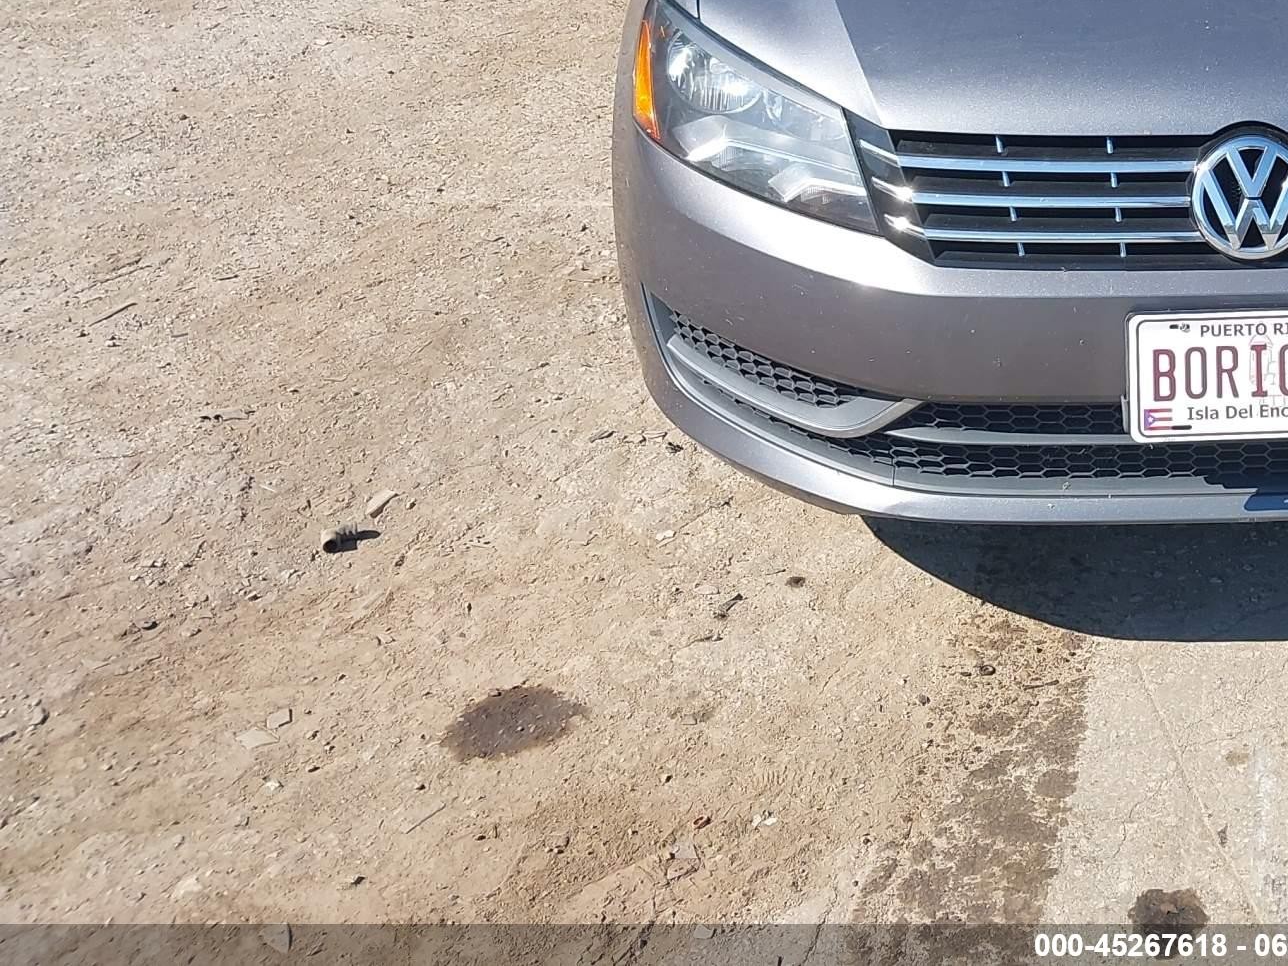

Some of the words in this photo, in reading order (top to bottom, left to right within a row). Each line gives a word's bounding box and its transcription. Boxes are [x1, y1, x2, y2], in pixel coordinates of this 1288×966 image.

[1200, 322, 1267, 337] PUERTO
[1187, 406, 1219, 420] Isla
[1226, 405, 1253, 419] Del
